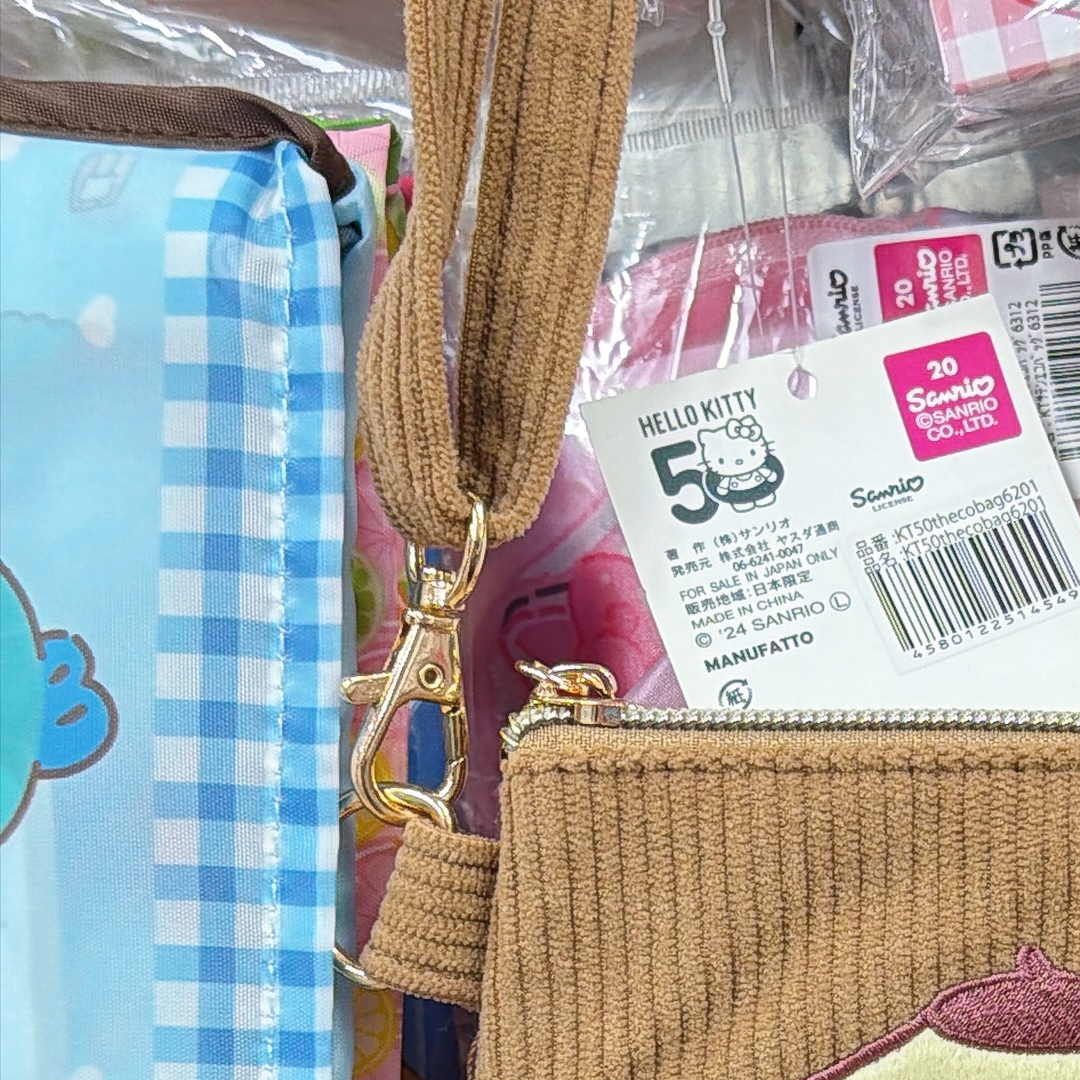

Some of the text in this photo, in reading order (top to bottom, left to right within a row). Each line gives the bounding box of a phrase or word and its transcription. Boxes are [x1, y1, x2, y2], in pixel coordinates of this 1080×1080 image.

[893, 278, 914, 308] 20
[1008, 301, 1023, 332] 6312
[1025, 298, 1040, 330] 6312
[925, 356, 958, 381] 20
[904, 369, 997, 415] Sanrio
[638, 387, 759, 439] HELLO KITTY
[914, 394, 999, 431] ©SANRIO
[848, 471, 926, 509] Sanrio
[871, 495, 914, 512] LICENSE
[712, 517, 791, 548] (株)サンリオ
[853, 532, 890, 559] 品番
[670, 556, 712, 577] 発売元
[718, 539, 771, 563] 株式会社
[679, 547, 839, 601] FOR SALE IN JAPAN ONLY
[731, 543, 805, 572] 06-6241-0047
[690, 589, 804, 629] MADE IN CHINA
[751, 599, 826, 631] SANRIO
[911, 589, 1080, 660] 4580122514549
[703, 630, 815, 672] MANUFATTO
